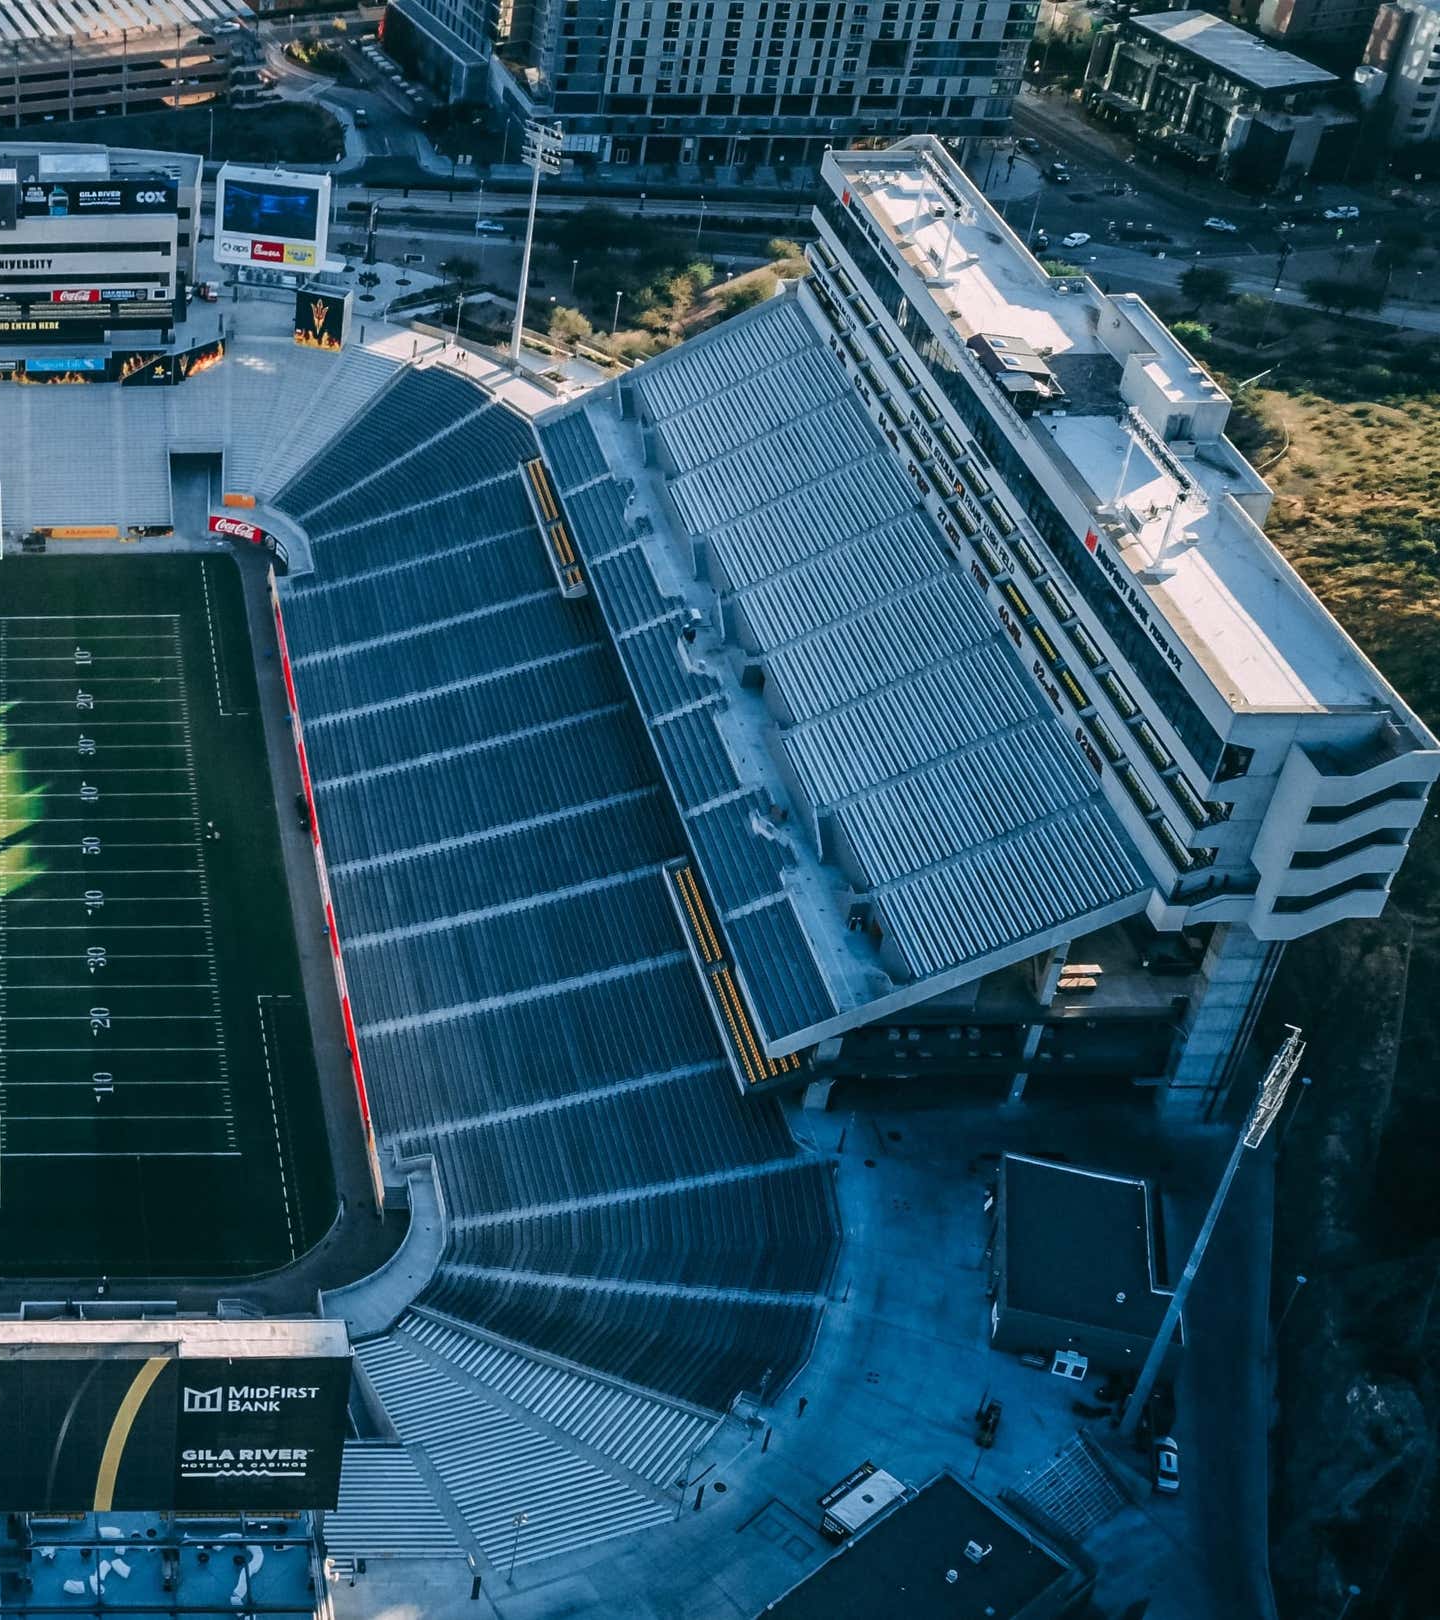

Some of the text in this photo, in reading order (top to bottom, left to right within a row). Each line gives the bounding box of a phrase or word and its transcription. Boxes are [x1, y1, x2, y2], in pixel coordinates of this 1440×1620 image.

[135, 192, 167, 203] COX
[11, 321, 36, 330] ENTER
[38, 321, 59, 330] HERE
[215, 519, 256, 540] Coca-Cola
[999, 546, 1016, 575] FIELD
[77, 693, 94, 710] 20
[79, 738, 96, 755] 30
[83, 837, 101, 854] 50
[85, 890, 104, 909] 40
[87, 946, 106, 967] 30
[90, 1007, 110, 1029] 20
[92, 1072, 114, 1093] 10
[228, 1386, 320, 1399] MIDFIRST
[228, 1400, 280, 1412] BANK
[182, 1449, 308, 1460] GILA RIVER
